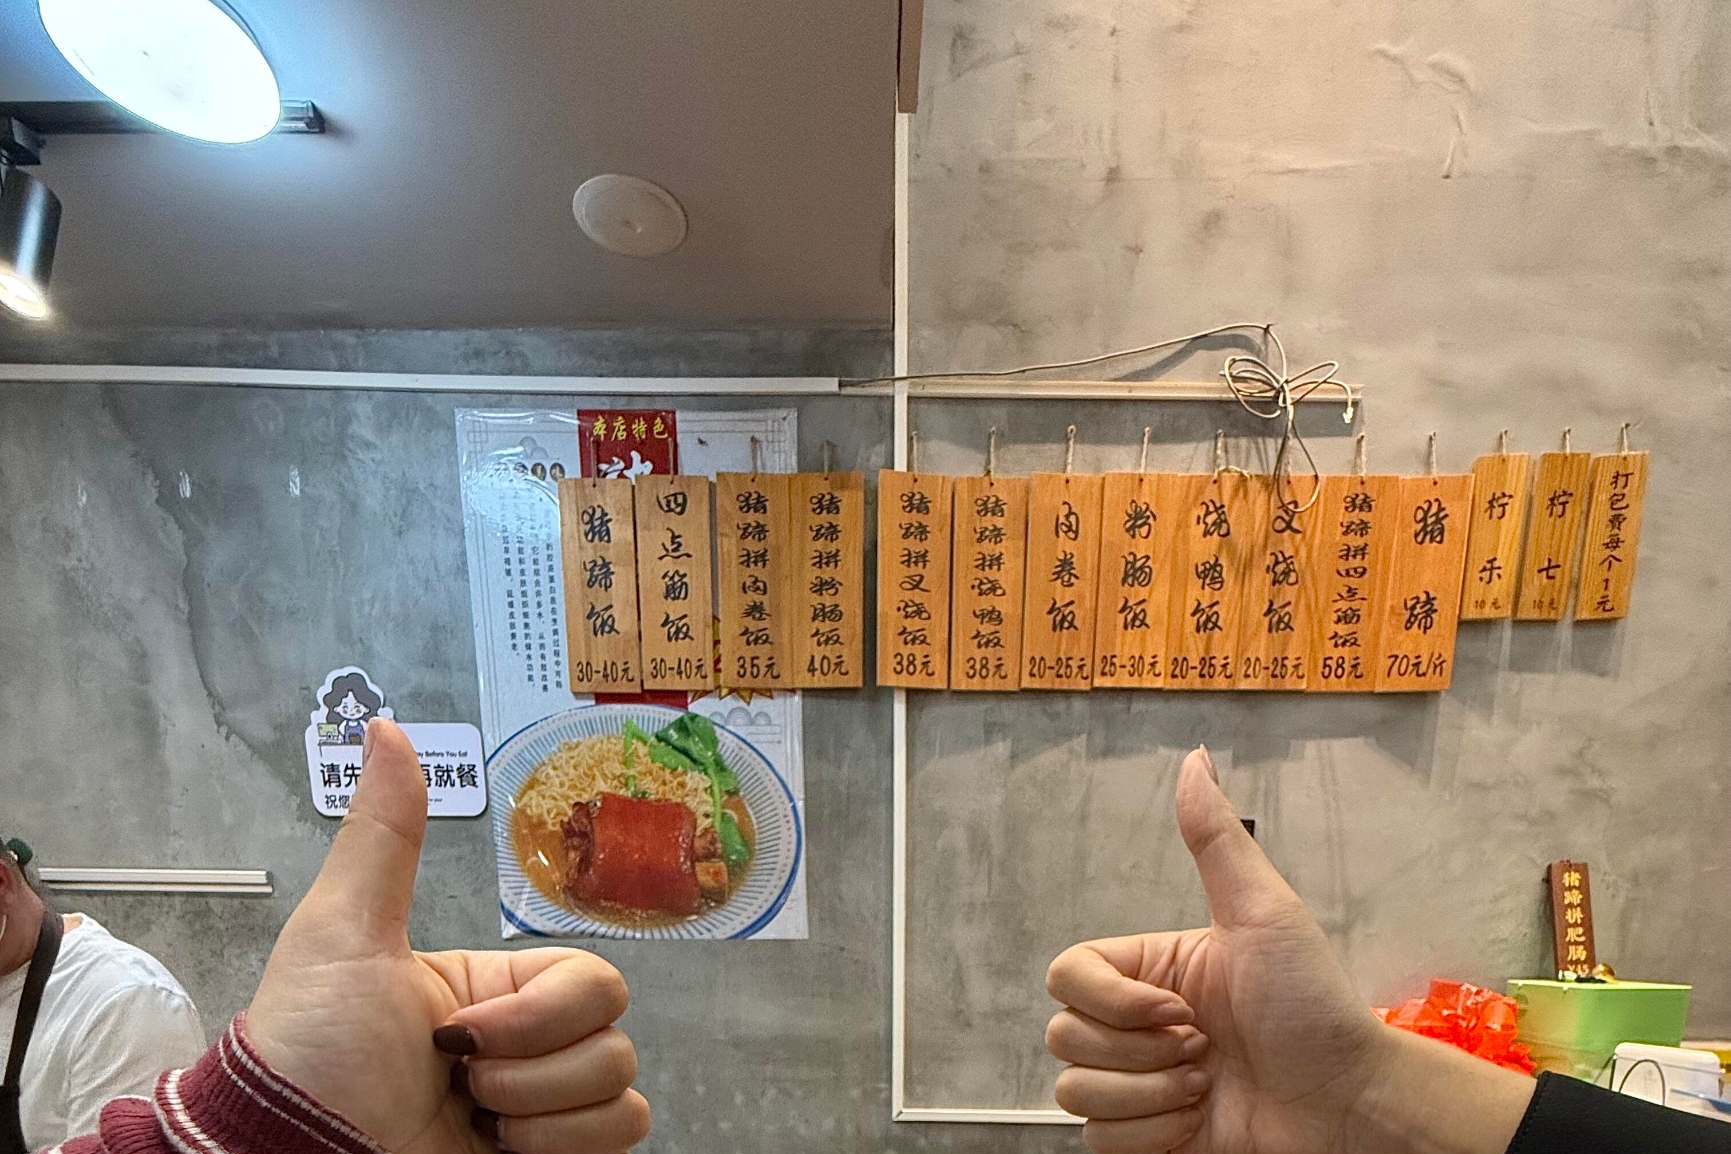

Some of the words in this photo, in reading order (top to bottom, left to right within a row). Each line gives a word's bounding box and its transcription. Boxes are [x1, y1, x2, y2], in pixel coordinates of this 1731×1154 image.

[593, 415, 669, 441] 本店特色
[581, 504, 620, 638] 猪蹄饭
[656, 491, 694, 643] 四点筋饭
[736, 491, 774, 646] 猪蹄拼肉卷饭
[809, 492, 844, 647] 猪蹄拼粉肠饭
[896, 491, 932, 647] 猪蹄拼叉烧饭
[970, 495, 1007, 649] 猪蹄拼烧鸭饭
[1047, 501, 1080, 633] 肉卷饭
[1118, 500, 1157, 631] 粉肠饭
[1191, 500, 1230, 633] 烧鸭饭
[1263, 500, 1302, 633] 叉烧饭
[1328, 493, 1376, 649] 猪蹄拼四点筋饭
[1403, 498, 1449, 636] 猪蹄
[1479, 491, 1513, 585] 柠乐
[1537, 490, 1573, 581] 柠七
[577, 660, 634, 684] 30-40元
[650, 657, 708, 680] 30-40元
[737, 655, 781, 680] 35元
[806, 655, 850, 678] 40元
[893, 653, 936, 677] 38元
[965, 657, 1008, 680] 38元
[1028, 657, 1090, 680] 20-25元
[1100, 655, 1162, 678] 25-30元
[1170, 656, 1234, 680] 20-25元
[1243, 657, 1306, 680] 20-25元
[1321, 656, 1364, 680] 58元
[1387, 655, 1447, 679] 70元/斤
[1562, 871, 1588, 962] 猪蹄拼肥肠
